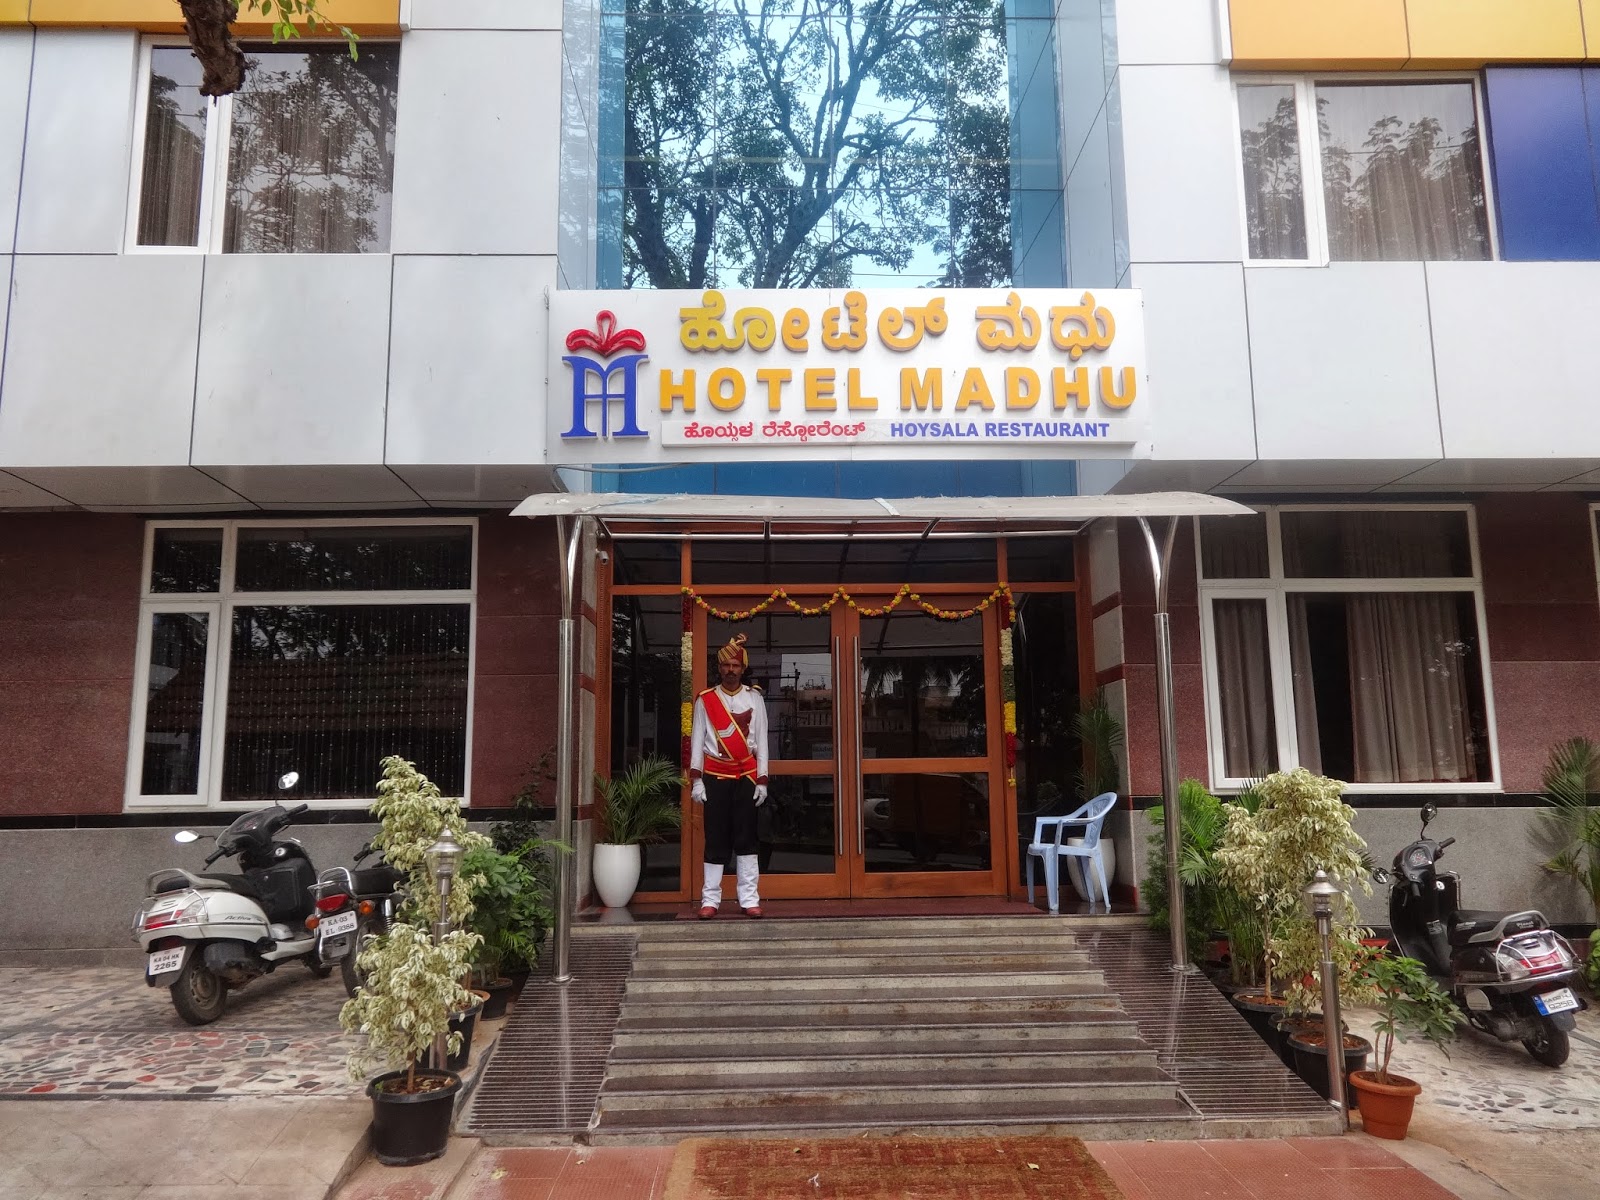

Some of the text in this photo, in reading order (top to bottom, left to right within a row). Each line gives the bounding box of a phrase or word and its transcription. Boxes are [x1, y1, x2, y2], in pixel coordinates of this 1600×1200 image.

[680, 289, 949, 352] ಹೋಟೆಲ್
[659, 366, 1137, 411] HOTEL MADHU
[890, 422, 1110, 437] HOYSALA RESTAURANT
[153, 959, 177, 971] 2265
